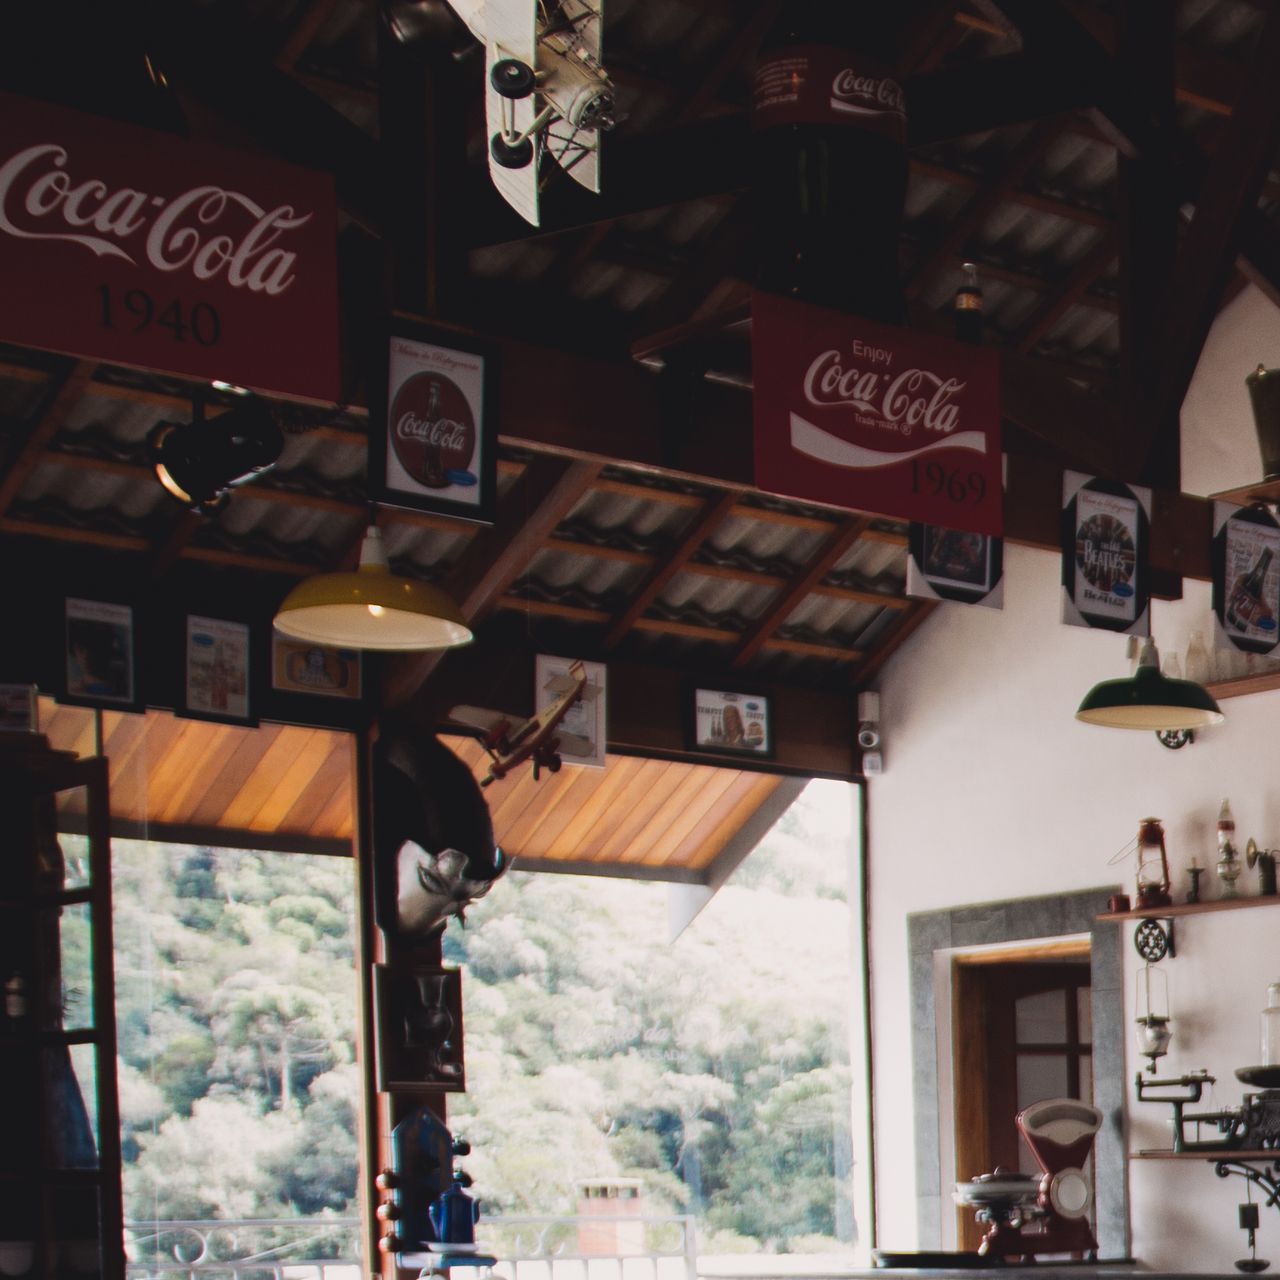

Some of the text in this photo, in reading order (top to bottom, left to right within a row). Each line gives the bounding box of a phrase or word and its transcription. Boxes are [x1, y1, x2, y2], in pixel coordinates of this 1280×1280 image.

[0, 144, 314, 297] Coca-Cola
[97, 282, 221, 348] 1940
[853, 339, 894, 366] Enjoy
[804, 350, 968, 433] Coca-Cola
[397, 411, 468, 451] Coca-Cola
[913, 460, 986, 504] 1969
